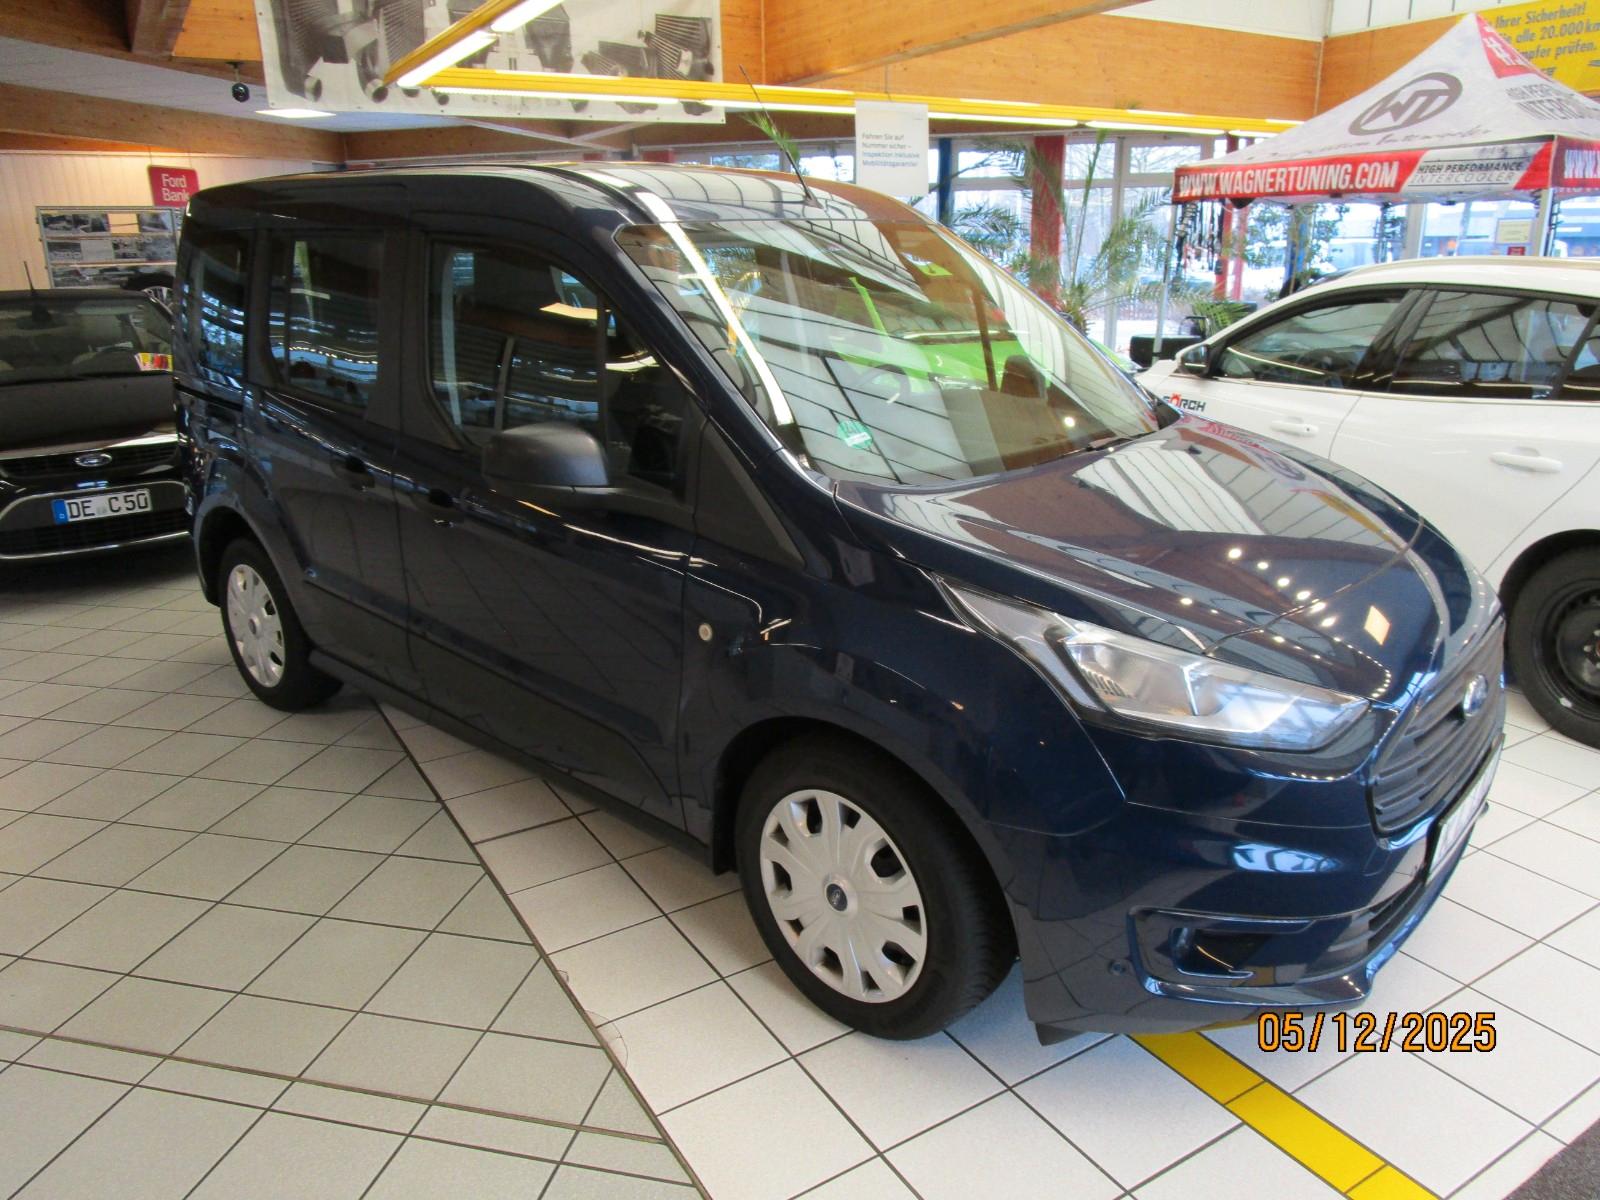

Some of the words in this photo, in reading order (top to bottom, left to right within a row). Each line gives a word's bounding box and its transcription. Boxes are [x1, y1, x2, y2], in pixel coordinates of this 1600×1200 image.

[1496, 16, 1521, 28] Ihrer
[1525, 3, 1586, 24] Sicherheit!
[1516, 28, 1537, 43] alle
[1554, 39, 1598, 60] prüfen.
[884, 133, 893, 141] Sie
[1417, 164, 1442, 174] HIGH
[1445, 161, 1524, 173] PERFORMANCE
[161, 173, 187, 188] Ford
[1179, 160, 1400, 197] WWW.WAGNERTUNING.COM
[1410, 171, 1516, 184] INTERCOOLER
[162, 187, 190, 202] Bank
[66, 499, 95, 519] DE
